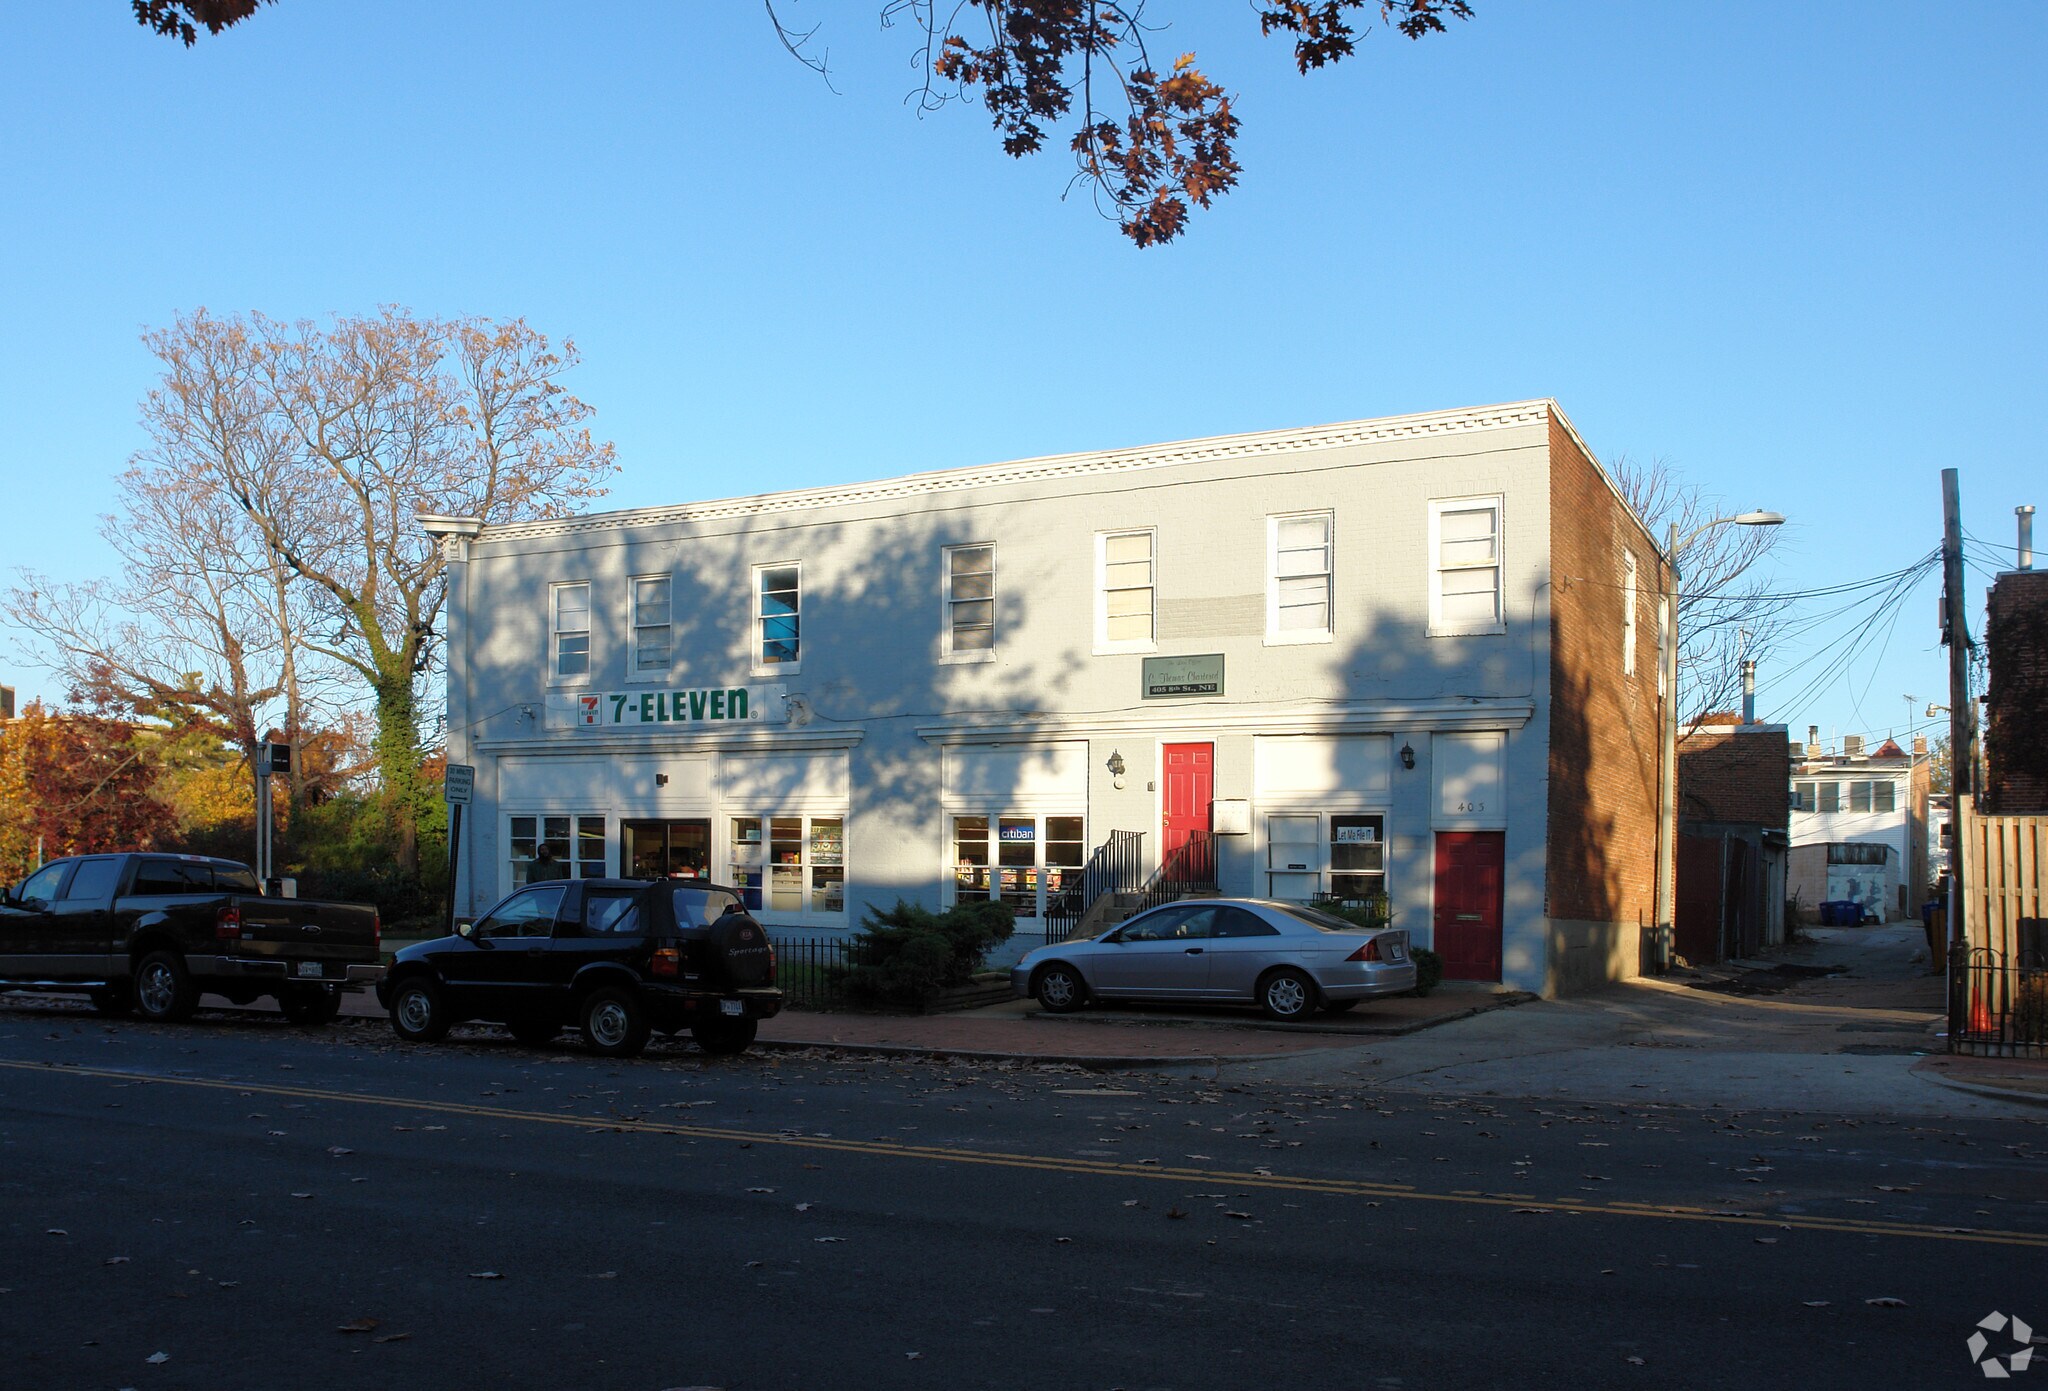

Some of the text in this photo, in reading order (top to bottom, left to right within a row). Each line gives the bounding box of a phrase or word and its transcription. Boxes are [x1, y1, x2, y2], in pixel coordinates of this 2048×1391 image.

[449, 776, 471, 785] PARKING
[1001, 829, 1033, 839] citiban
[728, 946, 767, 957] Sportage
